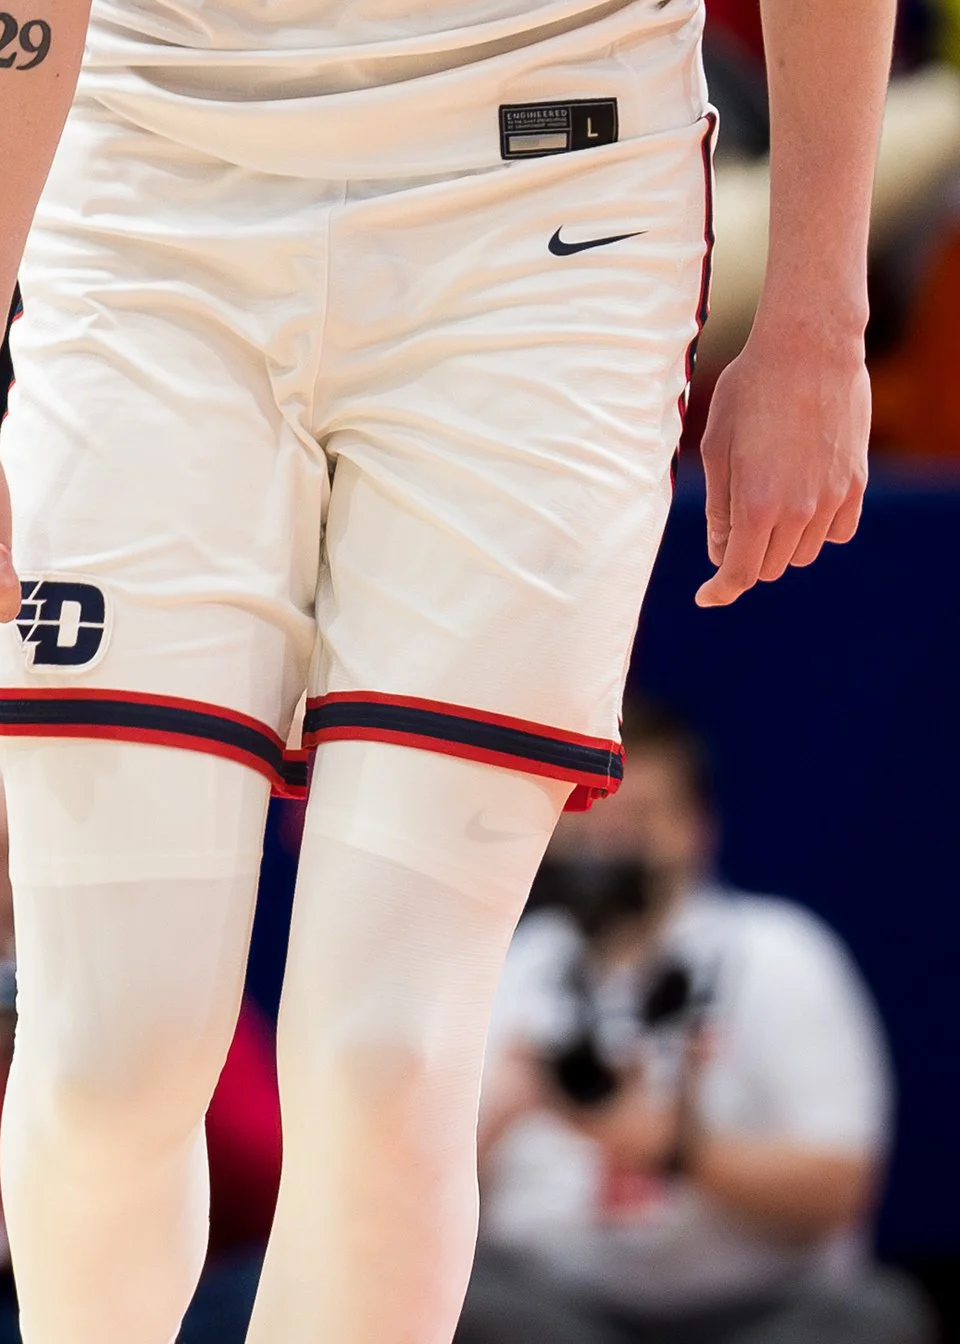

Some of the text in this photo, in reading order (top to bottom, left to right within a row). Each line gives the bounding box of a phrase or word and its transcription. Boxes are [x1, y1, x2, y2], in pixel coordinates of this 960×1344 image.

[506, 109, 568, 121] ENGINEERED
[586, 116, 599, 139] L
[14, 580, 106, 667] D
